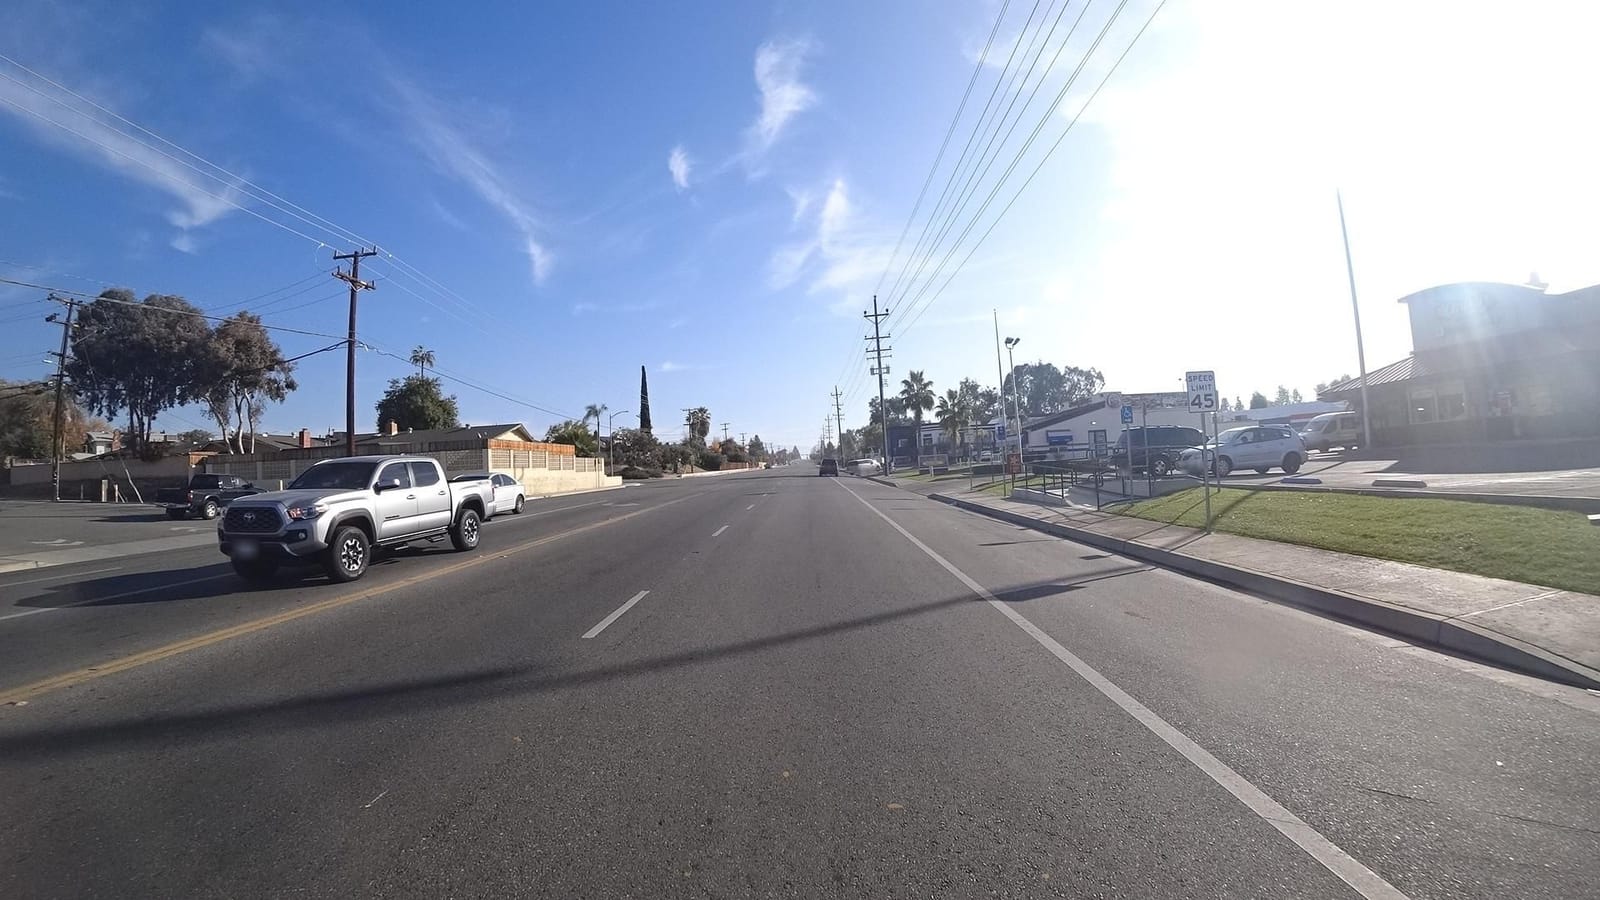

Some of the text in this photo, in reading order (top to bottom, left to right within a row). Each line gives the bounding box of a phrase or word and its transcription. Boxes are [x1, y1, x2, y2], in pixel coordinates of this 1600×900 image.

[1188, 374, 1213, 382] SPEED
[1191, 384, 1212, 392] LIMIT
[1191, 394, 1214, 409] 45
